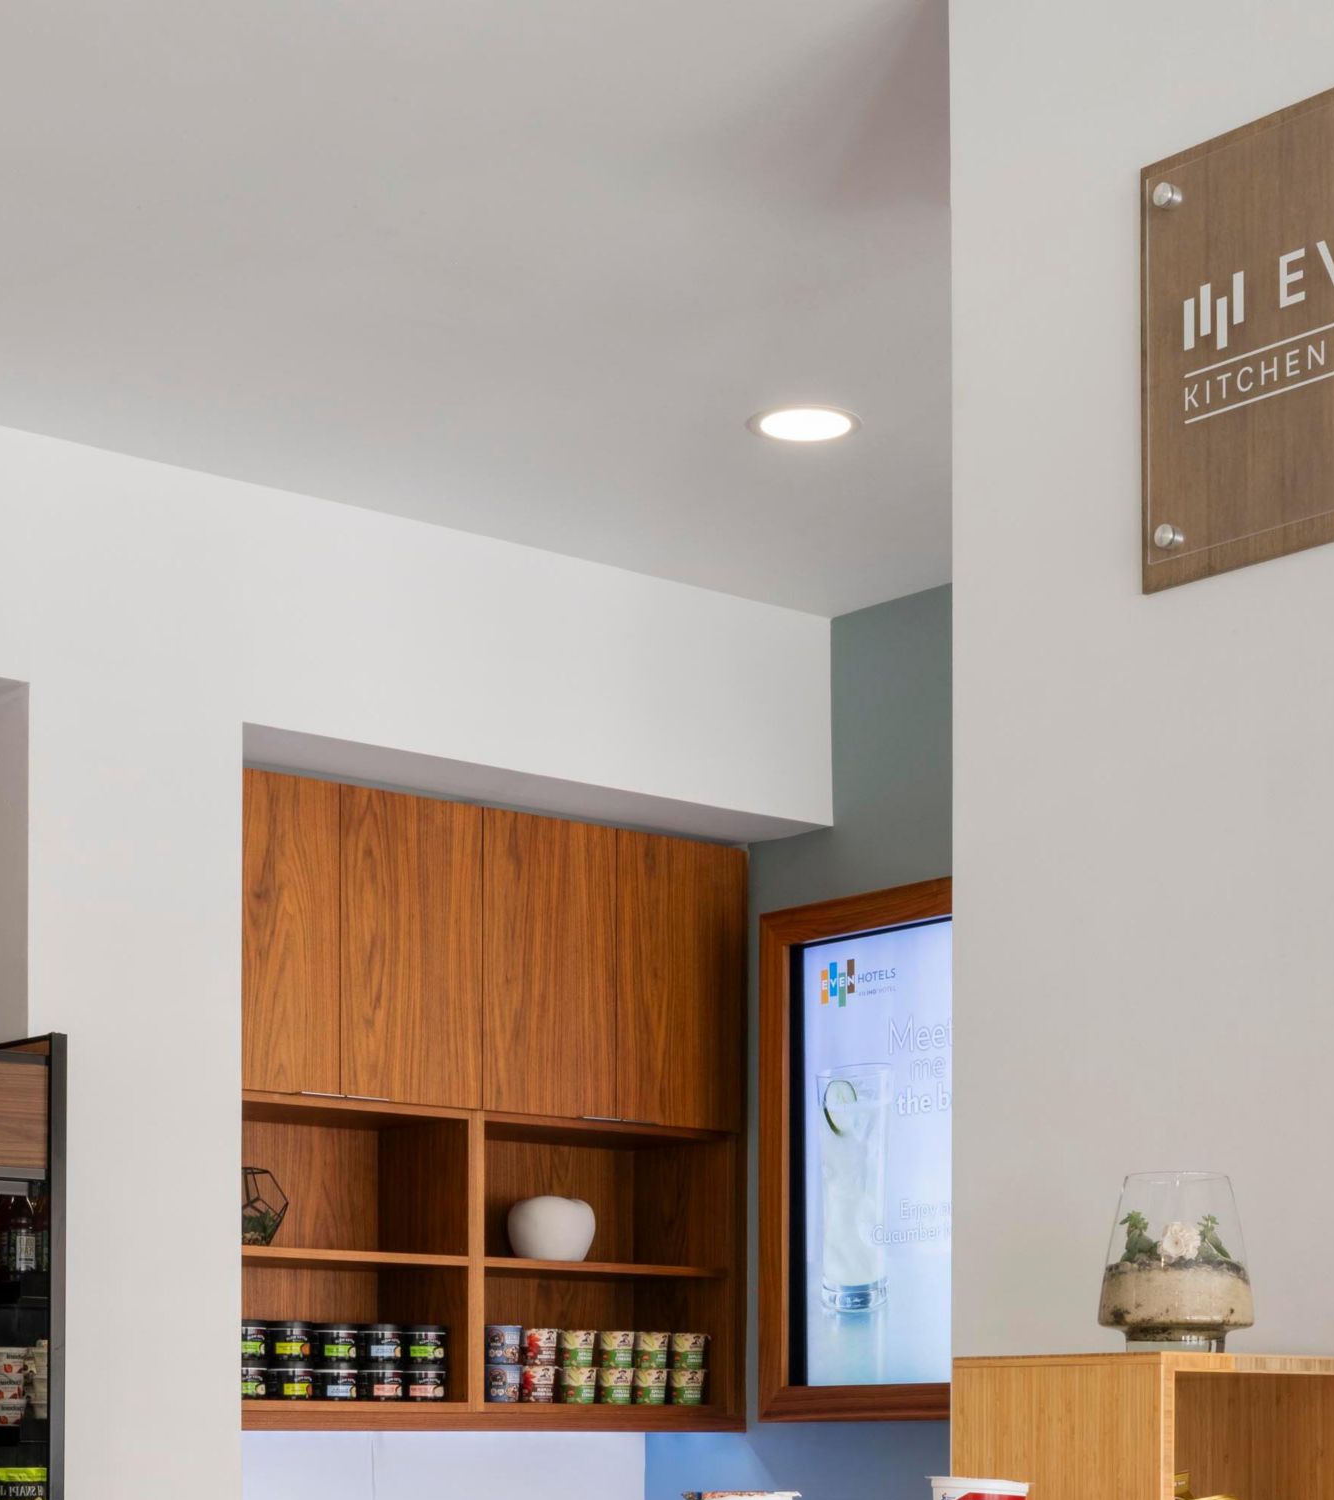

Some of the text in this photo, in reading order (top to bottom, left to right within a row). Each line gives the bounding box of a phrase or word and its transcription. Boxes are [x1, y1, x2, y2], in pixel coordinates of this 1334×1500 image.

[1184, 339, 1326, 412] KITCHEN
[858, 968, 896, 984] HOTELS
[889, 1014, 952, 1055] Meet
[912, 1057, 946, 1081] me
[873, 1223, 940, 1245] Cucumber
